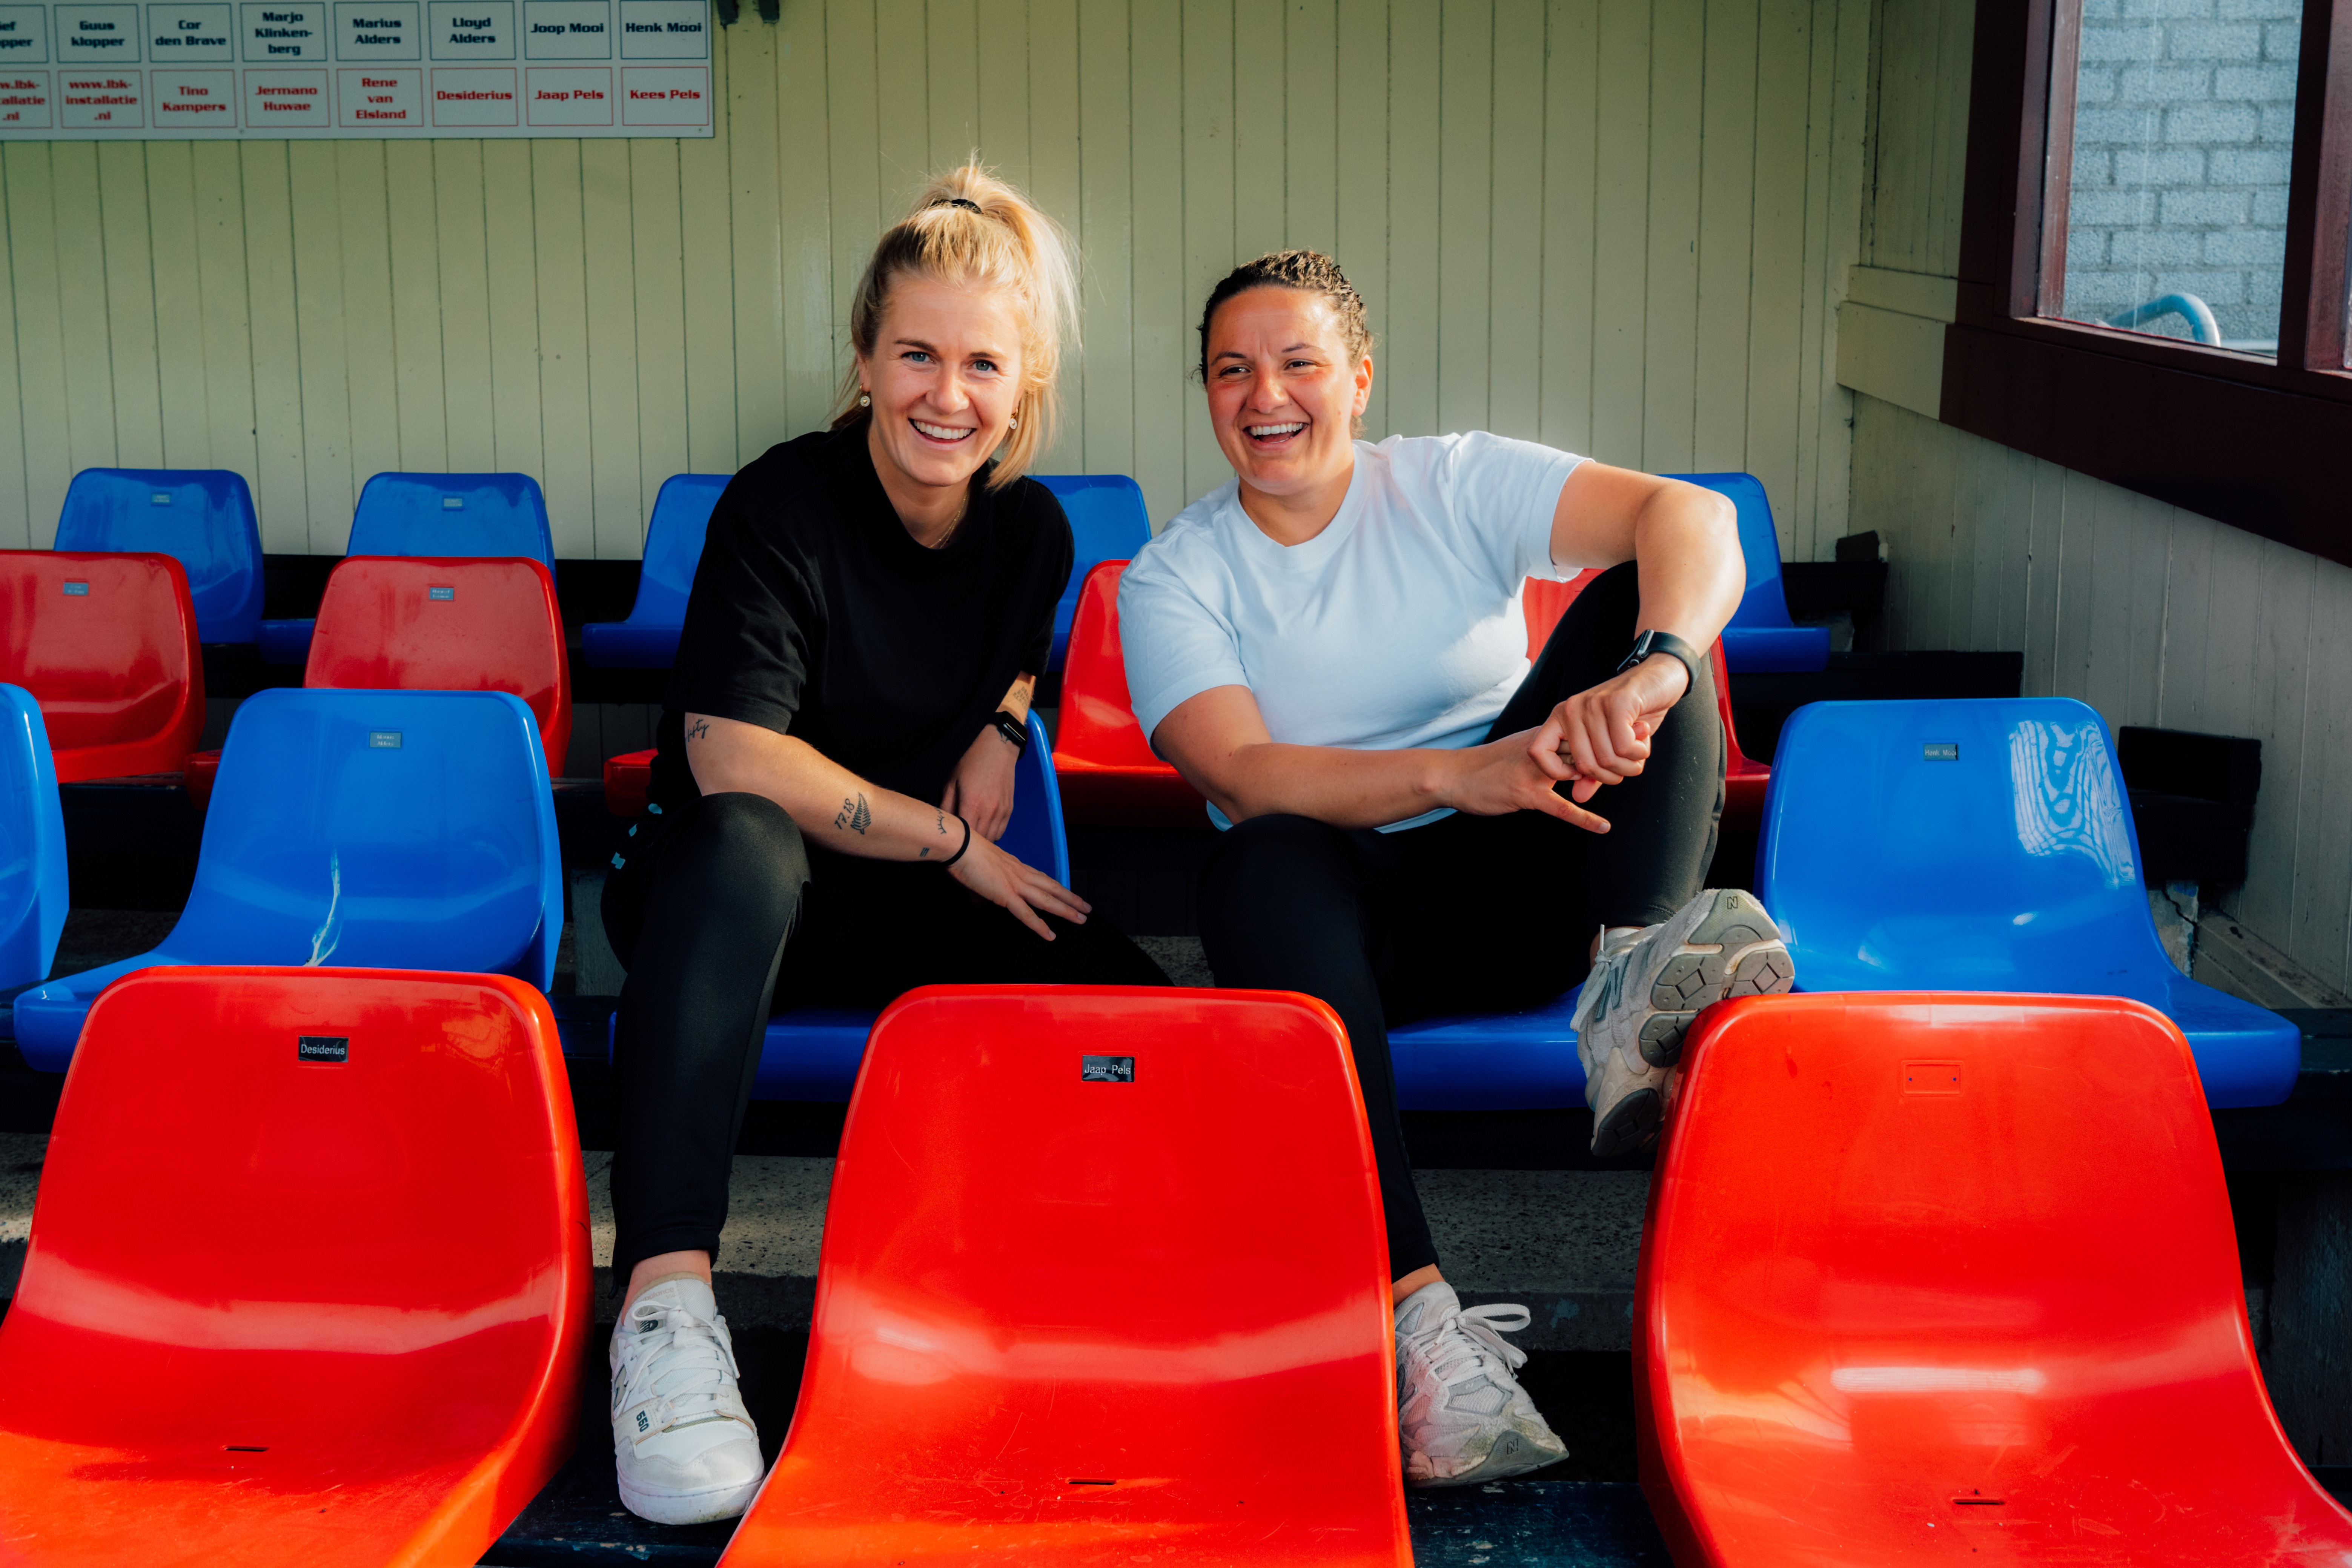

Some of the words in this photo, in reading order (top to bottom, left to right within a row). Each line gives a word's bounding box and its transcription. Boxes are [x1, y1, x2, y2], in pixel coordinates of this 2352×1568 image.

[263, 12, 303, 24] Marjo
[353, 18, 402, 28] Marius
[453, 17, 491, 29] Lloyd
[79, 21, 115, 30] Guus
[178, 20, 201, 29] Cor
[531, 23, 565, 35] Joop
[570, 23, 604, 32] Mooi
[625, 23, 662, 32] Henk
[667, 23, 702, 32] Mooi
[255, 28, 312, 38] Klinken-
[71, 37, 124, 48] klopper
[155, 36, 181, 46] den
[186, 36, 226, 46] Brave
[355, 34, 401, 44] Alders
[450, 34, 496, 43] Alders
[0, 39, 32, 49] pper
[268, 44, 301, 56] berg
[362, 78, 397, 87] Rene
[179, 86, 208, 95] Tino
[256, 86, 317, 95] Jermano
[437, 91, 512, 100] Desiderius
[535, 90, 569, 101] Jaap
[574, 90, 604, 99] Pels
[630, 90, 665, 99] Kees
[670, 89, 700, 99] Pels
[0, 96, 45, 105] allatie
[66, 95, 137, 104] installatie
[163, 102, 226, 113] Kampers
[264, 102, 310, 111] Huwae
[94, 111, 111, 120] .nl
[356, 110, 406, 119] Elsland
[301, 1044, 345, 1055] Desiderius
[1084, 1064, 1106, 1076] Jaap
[1112, 1064, 1131, 1075] Pels
[636, 1410, 649, 1433] 550
